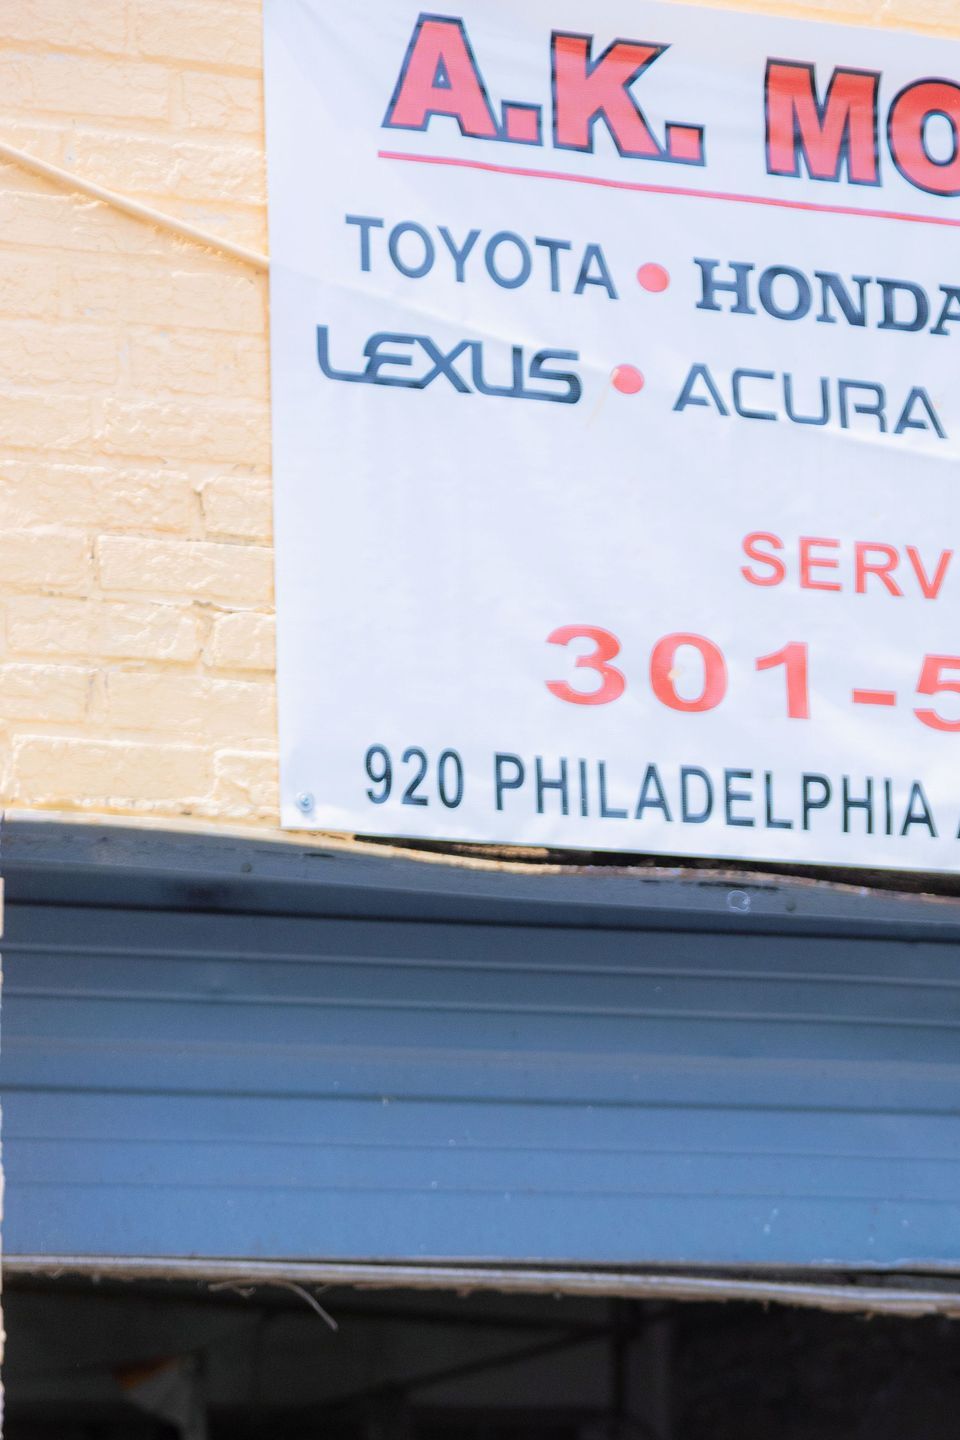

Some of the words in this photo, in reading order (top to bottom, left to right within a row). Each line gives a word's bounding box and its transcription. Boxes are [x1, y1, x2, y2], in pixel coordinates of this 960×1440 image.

[381, 12, 706, 166] A.K.
[345, 214, 619, 300] TOYOTA
[316, 325, 583, 404] LEXUS
[673, 363, 949, 440] ACURA
[365, 743, 464, 810] 920
[494, 752, 938, 839] PHILADELPHIA
